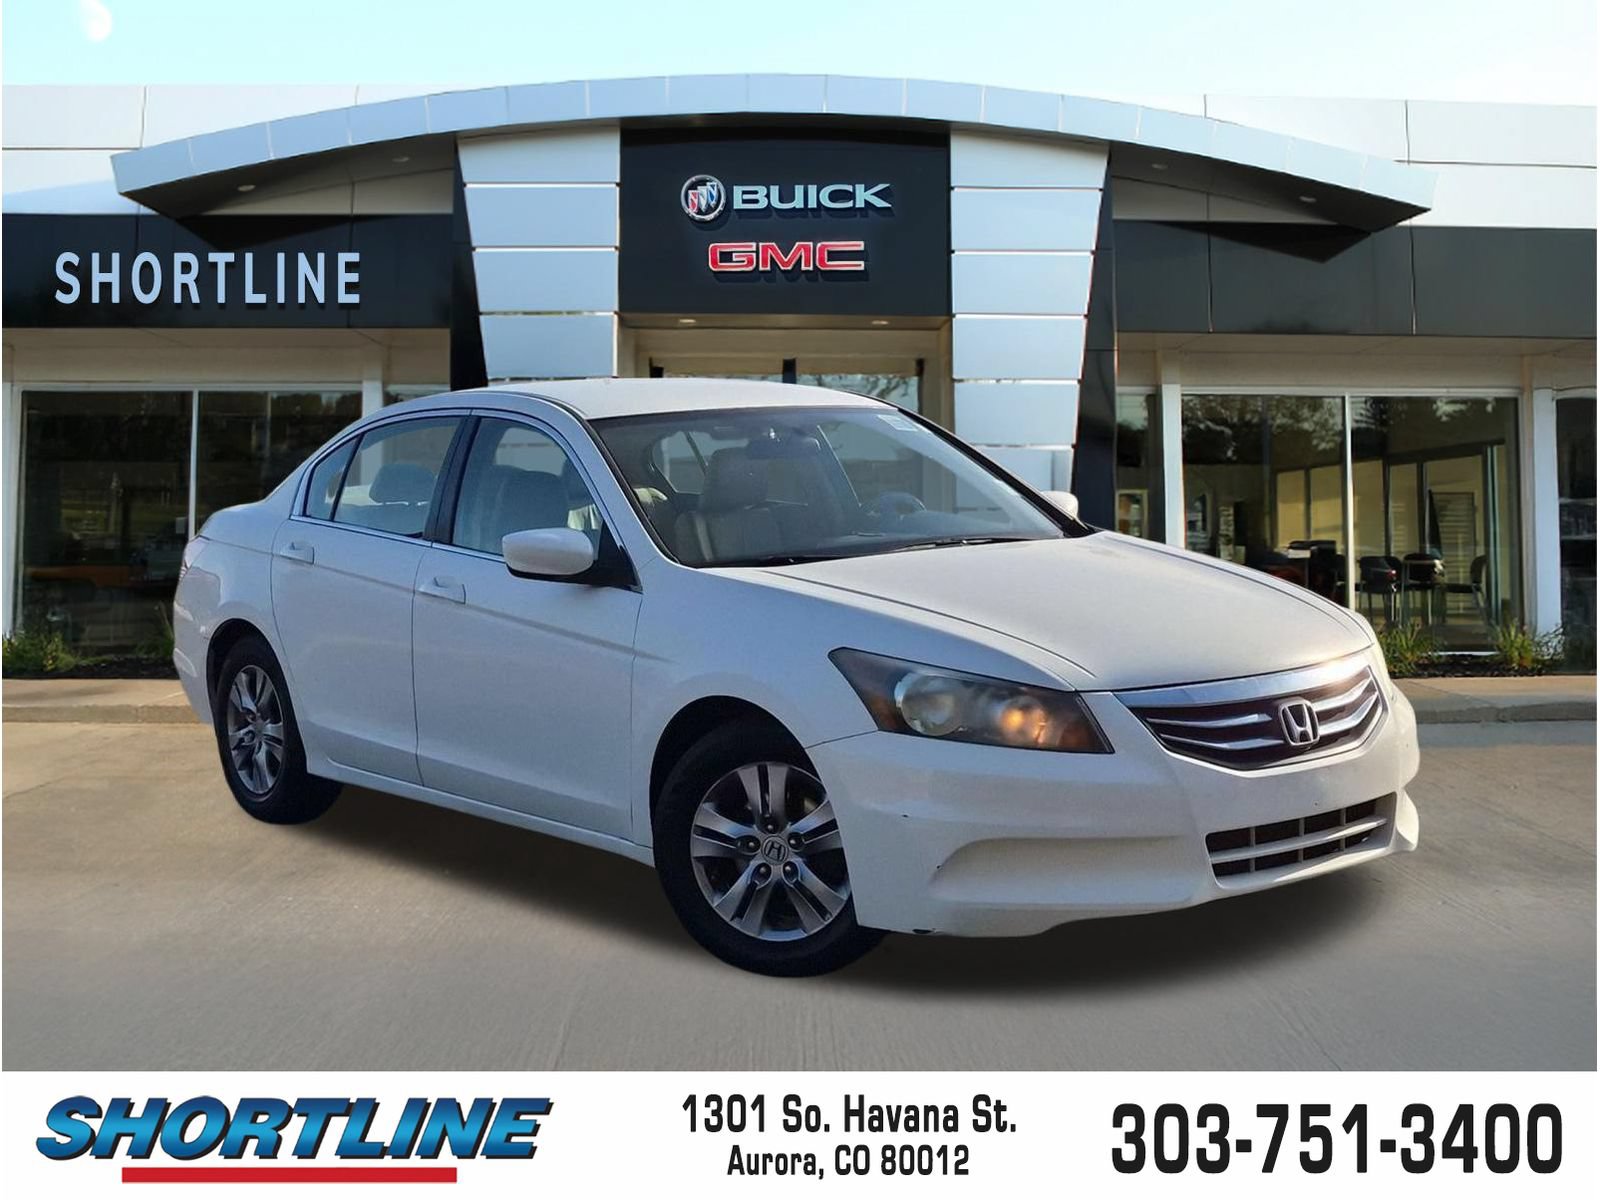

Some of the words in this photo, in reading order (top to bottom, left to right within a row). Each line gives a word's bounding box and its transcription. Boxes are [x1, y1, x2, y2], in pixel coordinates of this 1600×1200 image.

[733, 183, 892, 210] BUICK
[708, 240, 865, 272] GMC
[55, 251, 360, 304] SHORTLINE
